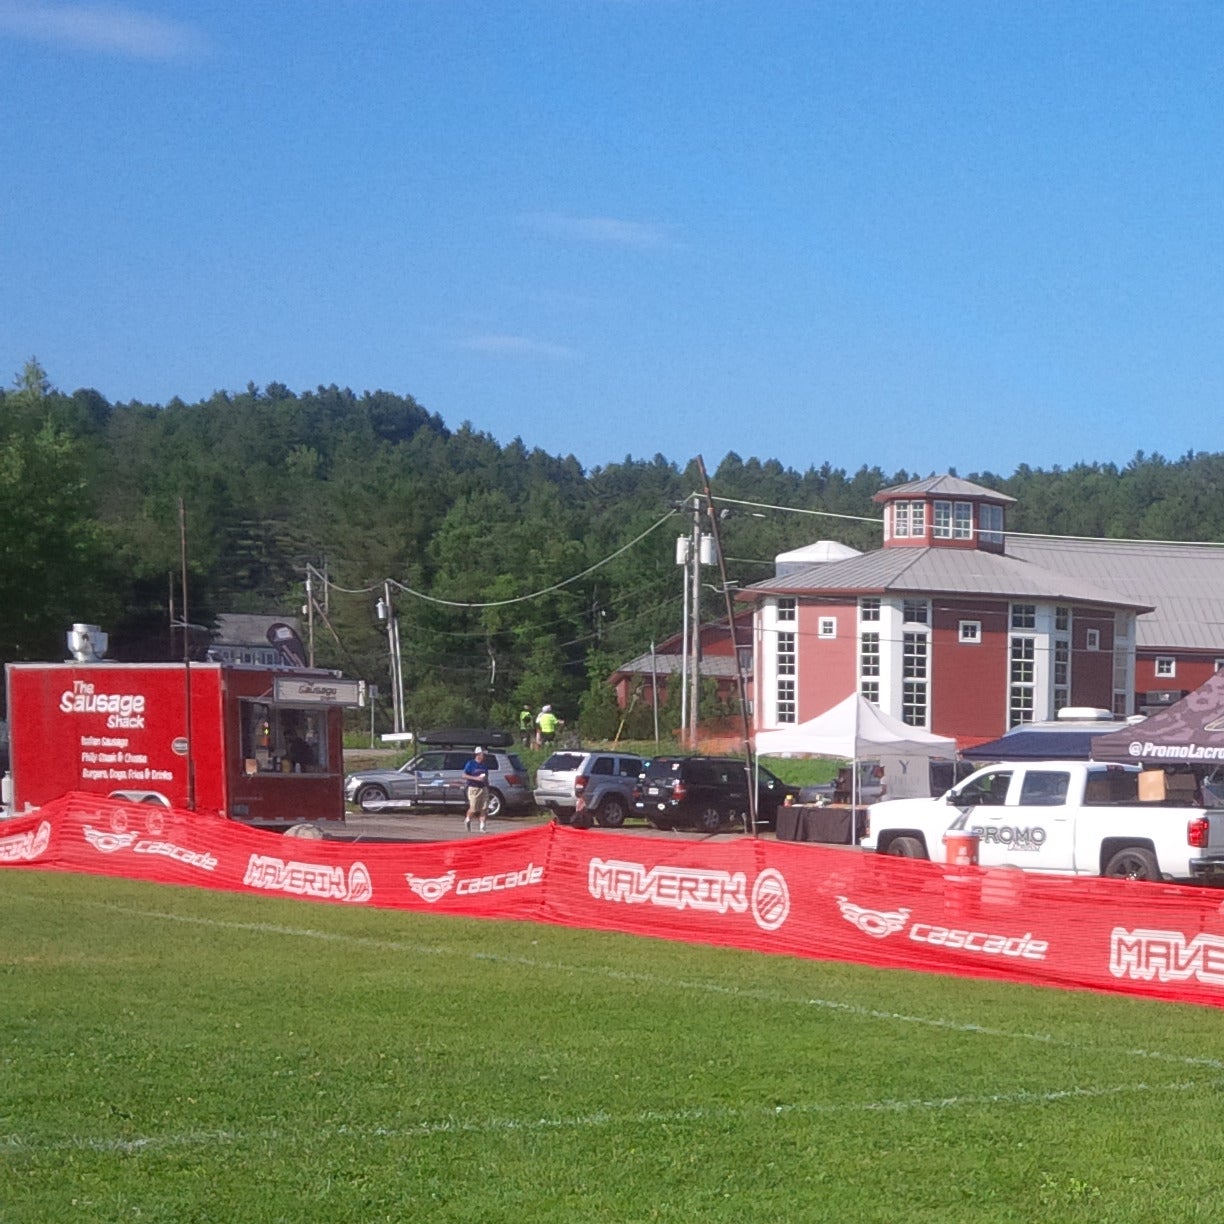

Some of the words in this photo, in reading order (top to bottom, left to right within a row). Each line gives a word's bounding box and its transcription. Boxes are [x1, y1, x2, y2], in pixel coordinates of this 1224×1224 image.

[73, 680, 95, 694] The
[59, 691, 145, 715] Sausage
[107, 715, 145, 728] Shack
[971, 825, 1046, 846] PROMO
[133, 840, 218, 871] cascade
[244, 855, 346, 898] MAVERIK
[456, 863, 544, 895] cascade
[589, 858, 748, 913] MAVERIK
[909, 923, 1049, 960] cascade
